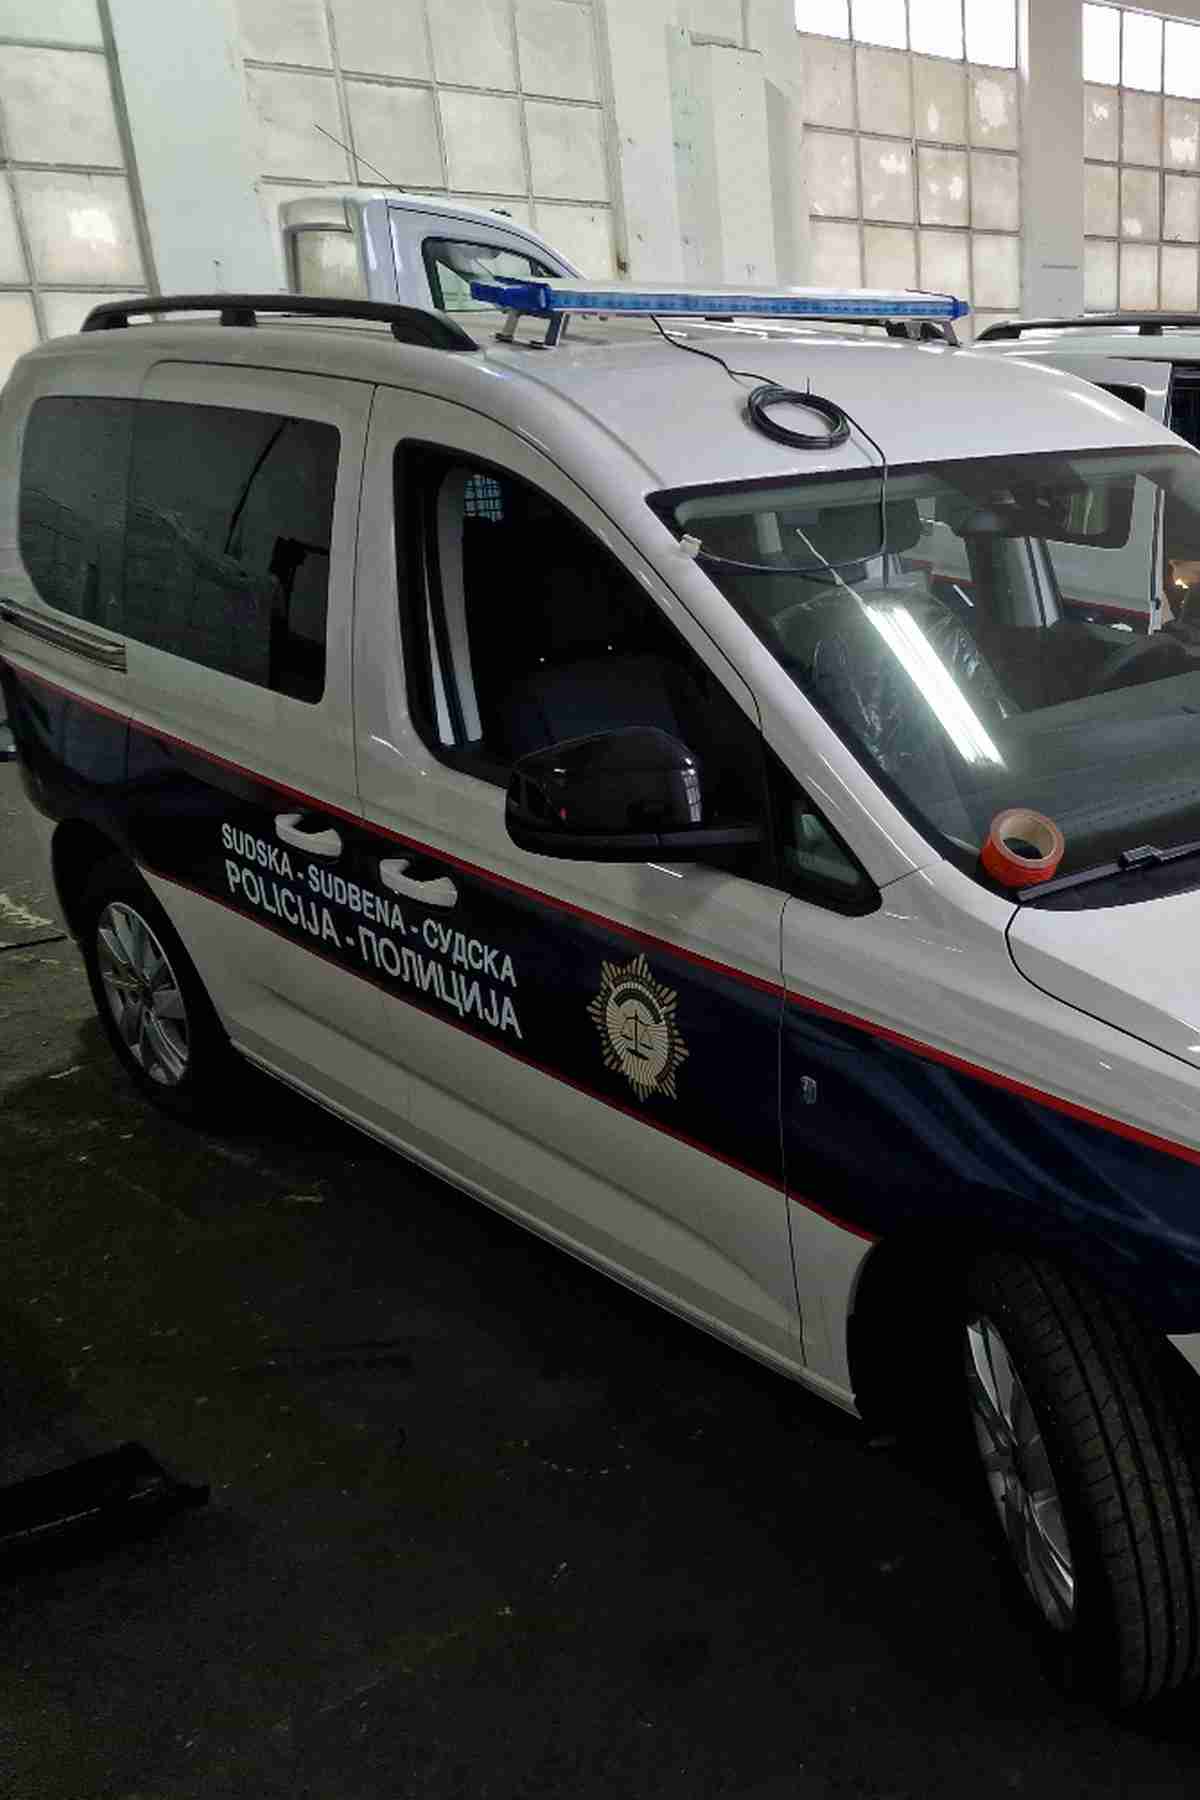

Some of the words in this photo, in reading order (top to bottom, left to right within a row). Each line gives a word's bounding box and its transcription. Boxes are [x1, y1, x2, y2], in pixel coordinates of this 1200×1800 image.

[222, 823, 294, 881] SUDSKA
[308, 863, 407, 935] SUDBENA
[422, 918, 517, 988] СУДСКА
[225, 859, 342, 948] POLICIJA
[358, 925, 523, 1039] ПОЛИЦИЈА
